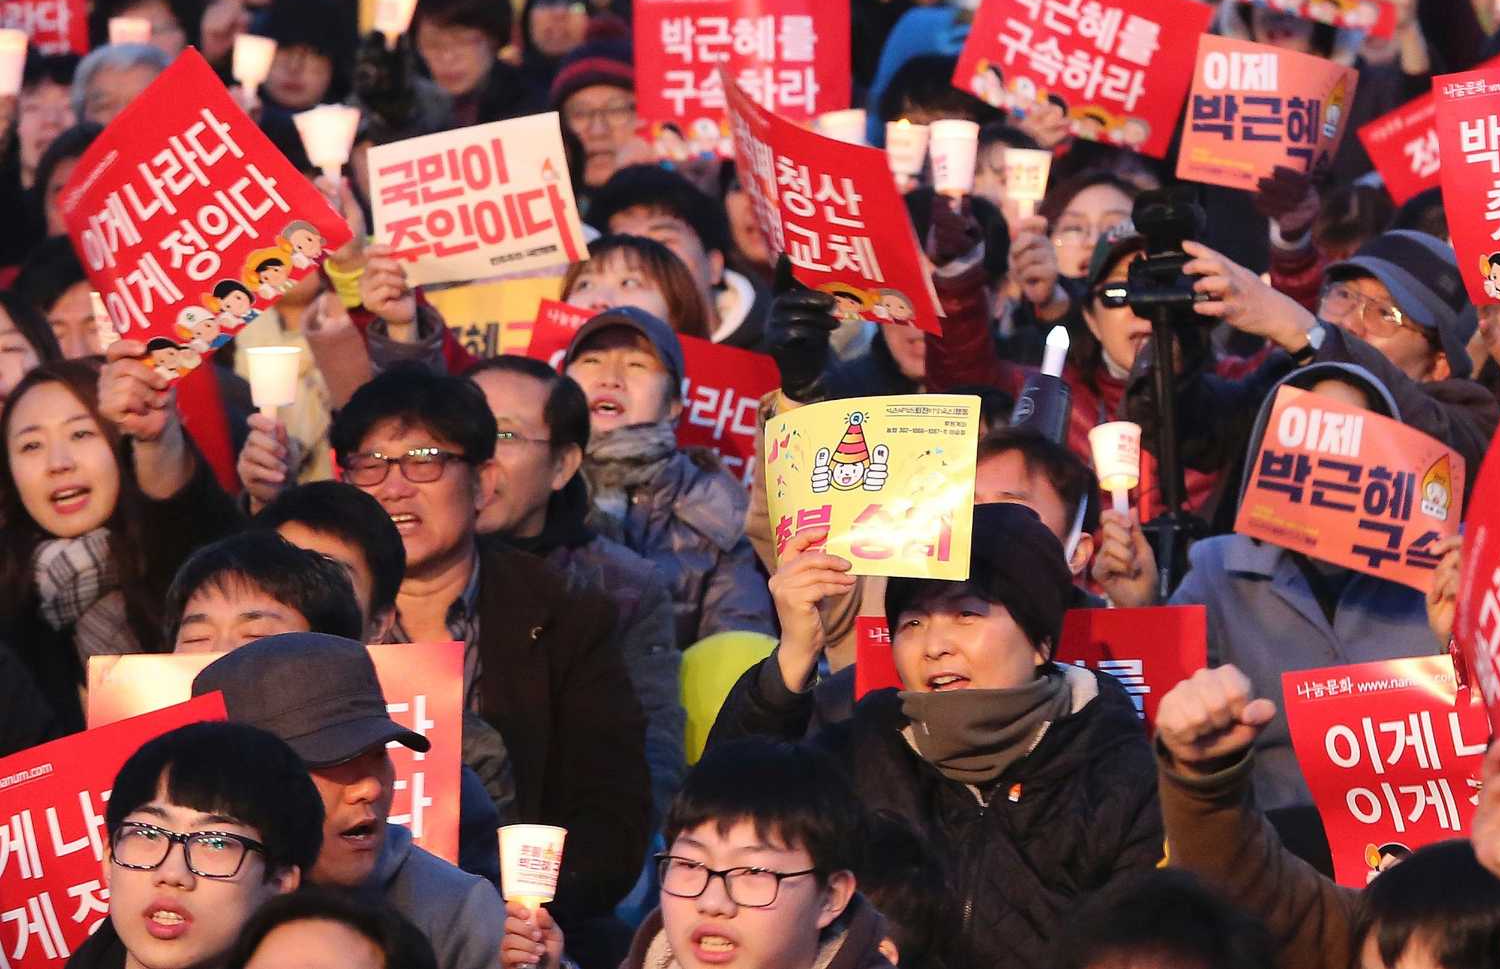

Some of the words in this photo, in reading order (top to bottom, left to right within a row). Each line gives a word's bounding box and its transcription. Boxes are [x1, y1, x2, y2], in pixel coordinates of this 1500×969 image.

[660, 12, 819, 64] 박근혜를
[998, 17, 1146, 113] 구속하라
[1203, 50, 1279, 92] 이제
[1192, 94, 1321, 145] 박근혜
[80, 190, 143, 272] 이게
[121, 106, 245, 223] 나라다
[378, 137, 511, 208] 국민이
[775, 155, 866, 229] 청산
[104, 251, 185, 335] 이게
[158, 162, 292, 282] 정의다
[384, 183, 581, 265] 주인이다
[784, 221, 886, 283] 교체
[1277, 405, 1365, 458] 이제
[1255, 449, 1417, 522] 박근혜
[1324, 709, 1443, 776] 이게
[1345, 776, 1463, 834] 이게
